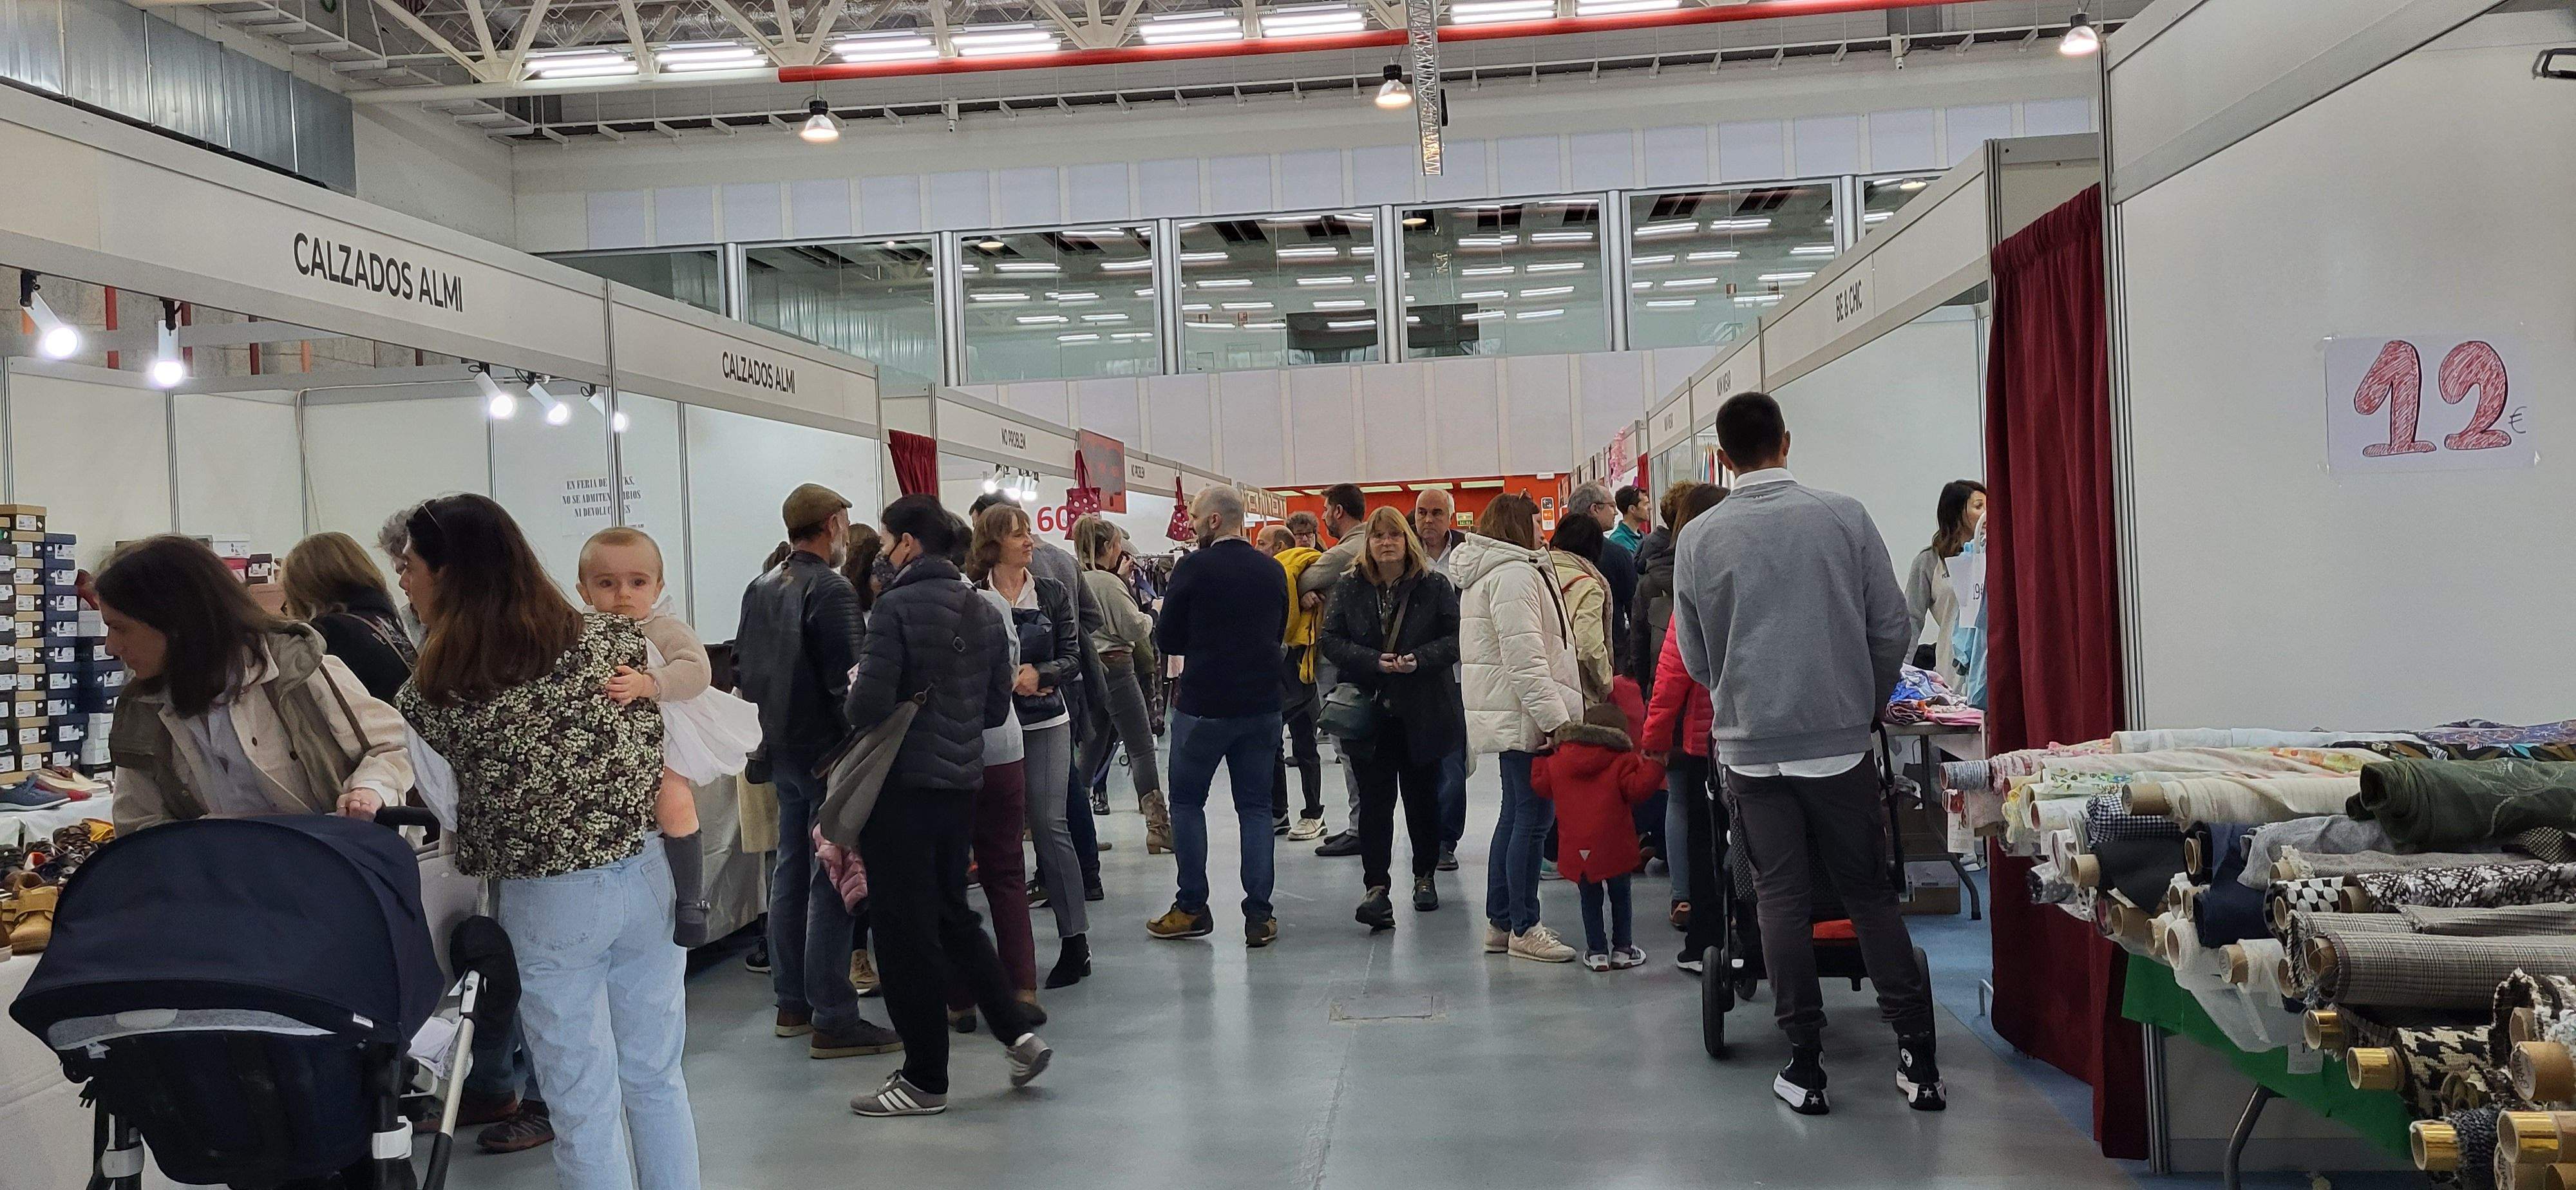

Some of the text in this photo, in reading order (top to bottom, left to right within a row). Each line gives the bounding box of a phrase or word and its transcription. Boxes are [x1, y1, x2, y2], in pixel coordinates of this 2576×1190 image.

[293, 232, 463, 313] CALZADOS ALMI
[1835, 294, 1844, 323] BE
[722, 351, 795, 394] CALZADOS ALMI
[1001, 428, 1027, 450] NO PROBLEM
[598, 478, 607, 487] DE
[562, 495, 571, 505] NO
